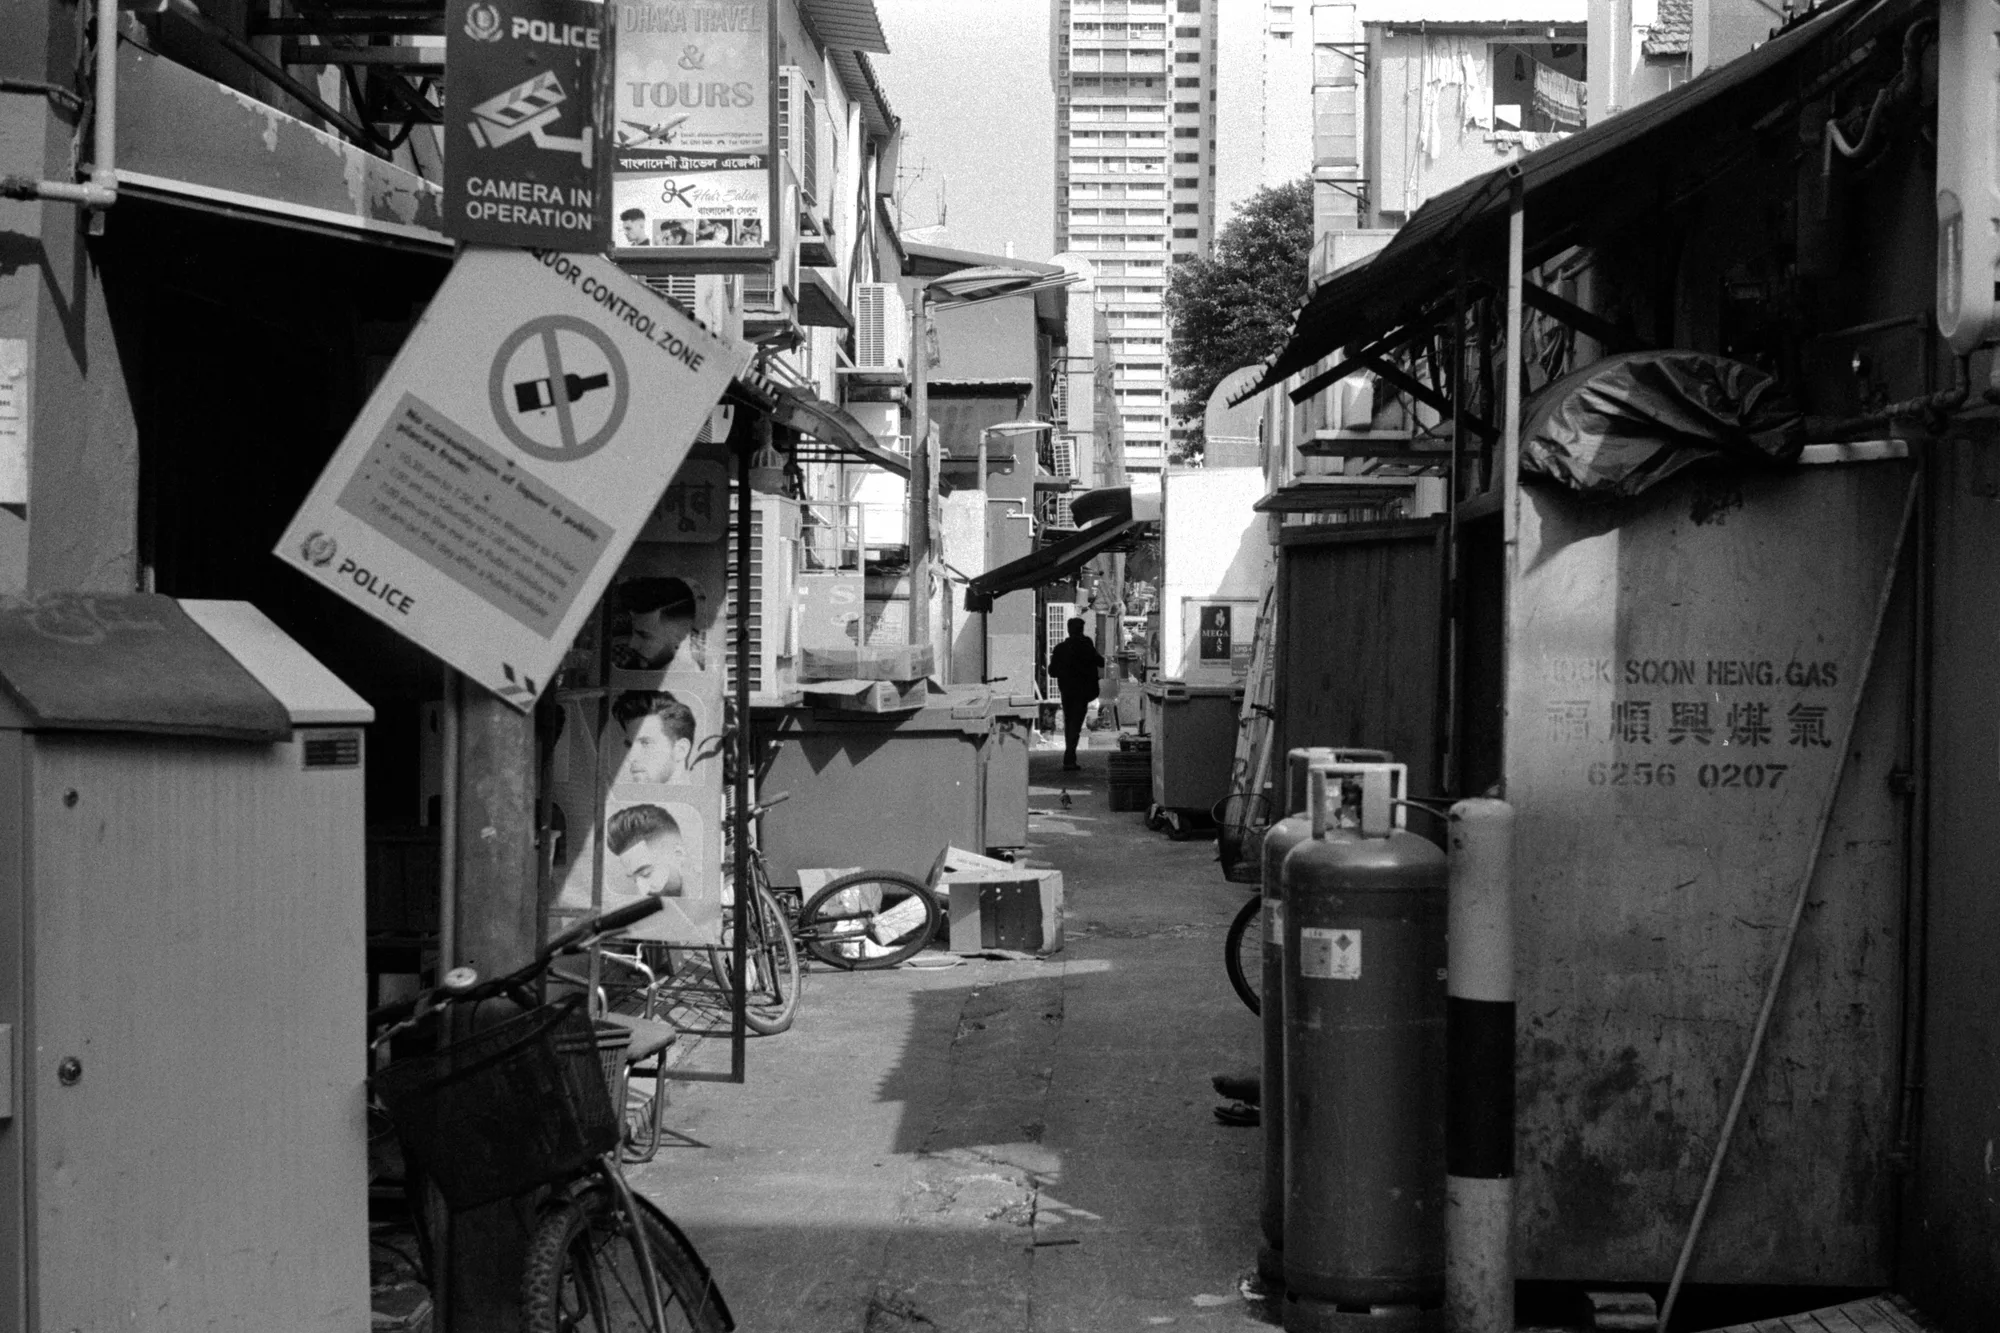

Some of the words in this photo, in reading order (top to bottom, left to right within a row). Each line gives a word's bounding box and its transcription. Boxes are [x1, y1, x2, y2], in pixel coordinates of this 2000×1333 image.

[511, 16, 600, 49] POLICE
[624, 4, 687, 33] DHAKA
[692, 4, 762, 33] TRAVEL
[677, 44, 706, 71] &
[625, 80, 755, 110] TOURS
[466, 176, 566, 206] CAMERA
[570, 187, 593, 209] IN
[466, 200, 593, 232] OPERATION
[581, 276, 655, 341] CONTROL
[657, 331, 706, 373] ZONE
[337, 557, 416, 616] POLICE
[1624, 658, 1696, 686] SOON
[1587, 762, 1677, 788] 6256
[1697, 763, 1789, 789] 0207
